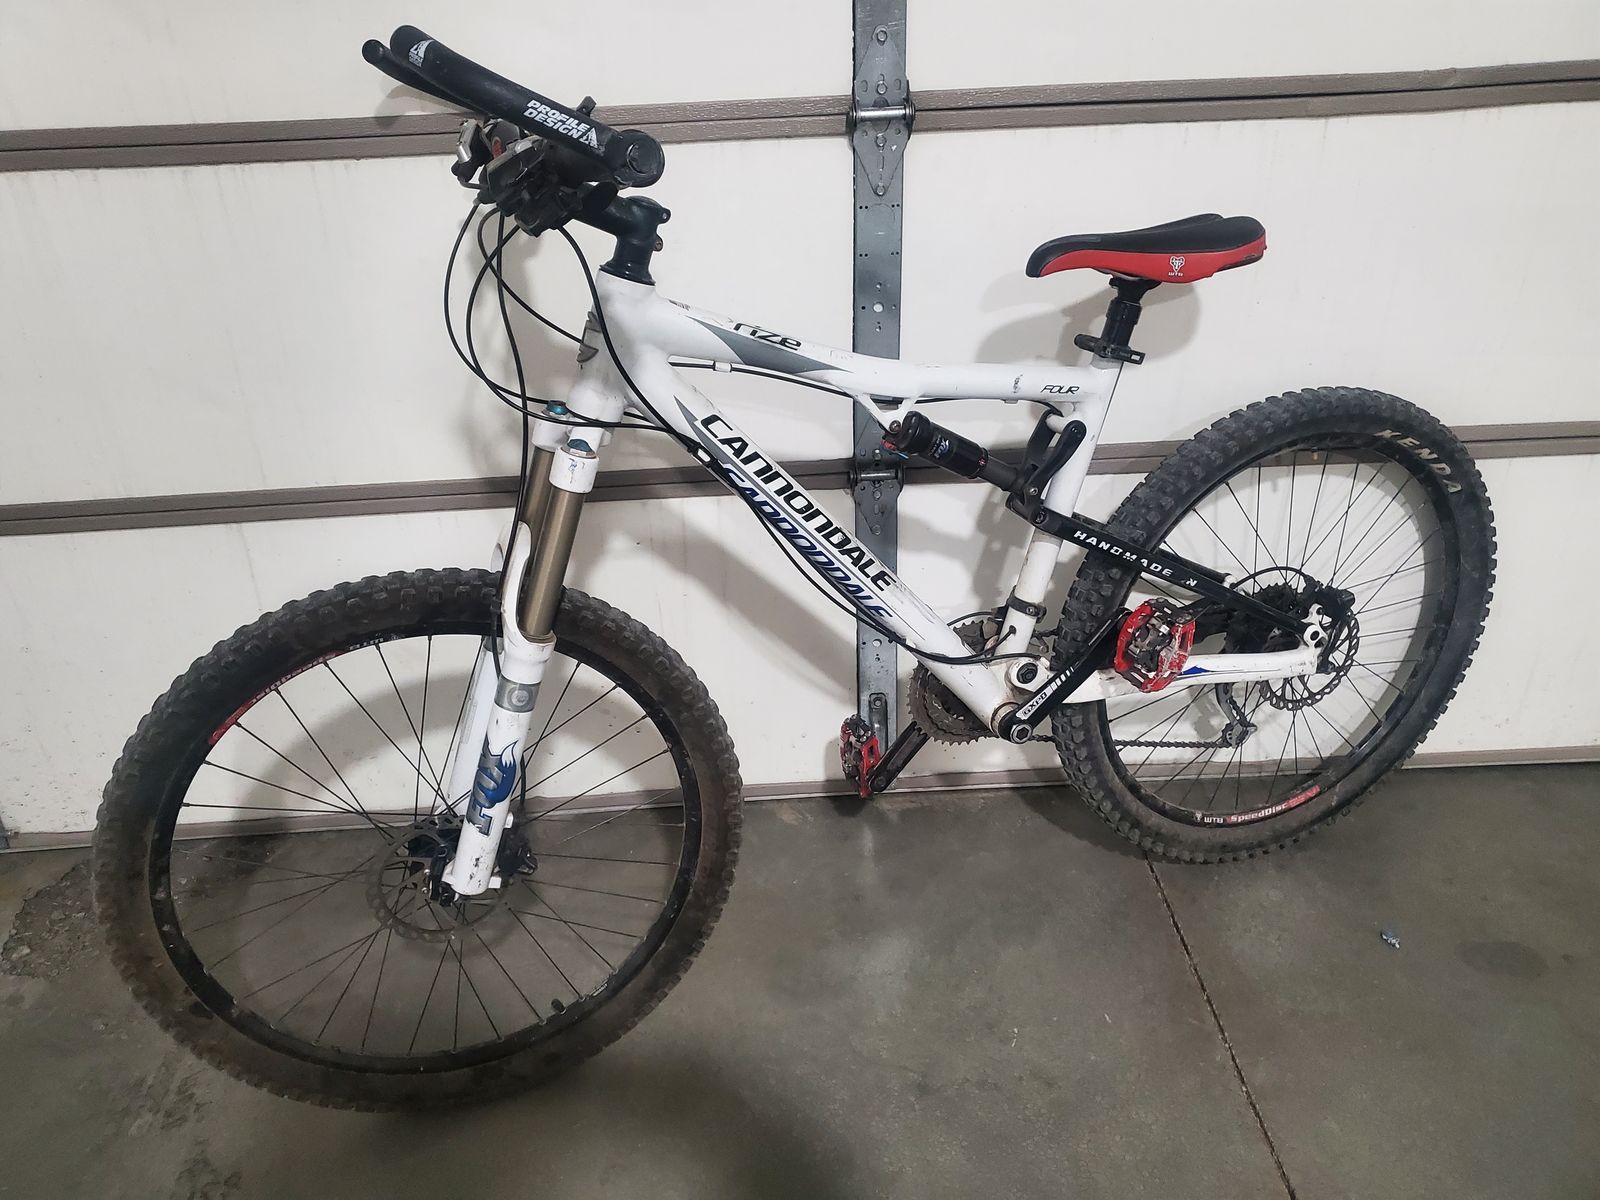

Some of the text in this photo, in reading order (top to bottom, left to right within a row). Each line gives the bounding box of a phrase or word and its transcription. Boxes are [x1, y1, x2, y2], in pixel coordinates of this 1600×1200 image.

[523, 108, 583, 139] DESIGN
[527, 99, 590, 132] PROFILE
[1041, 384, 1080, 394] FOUR
[1373, 429, 1462, 493] KENDA
[1074, 530, 1174, 577] HANDMADE
[1204, 816, 1224, 824] WTB
